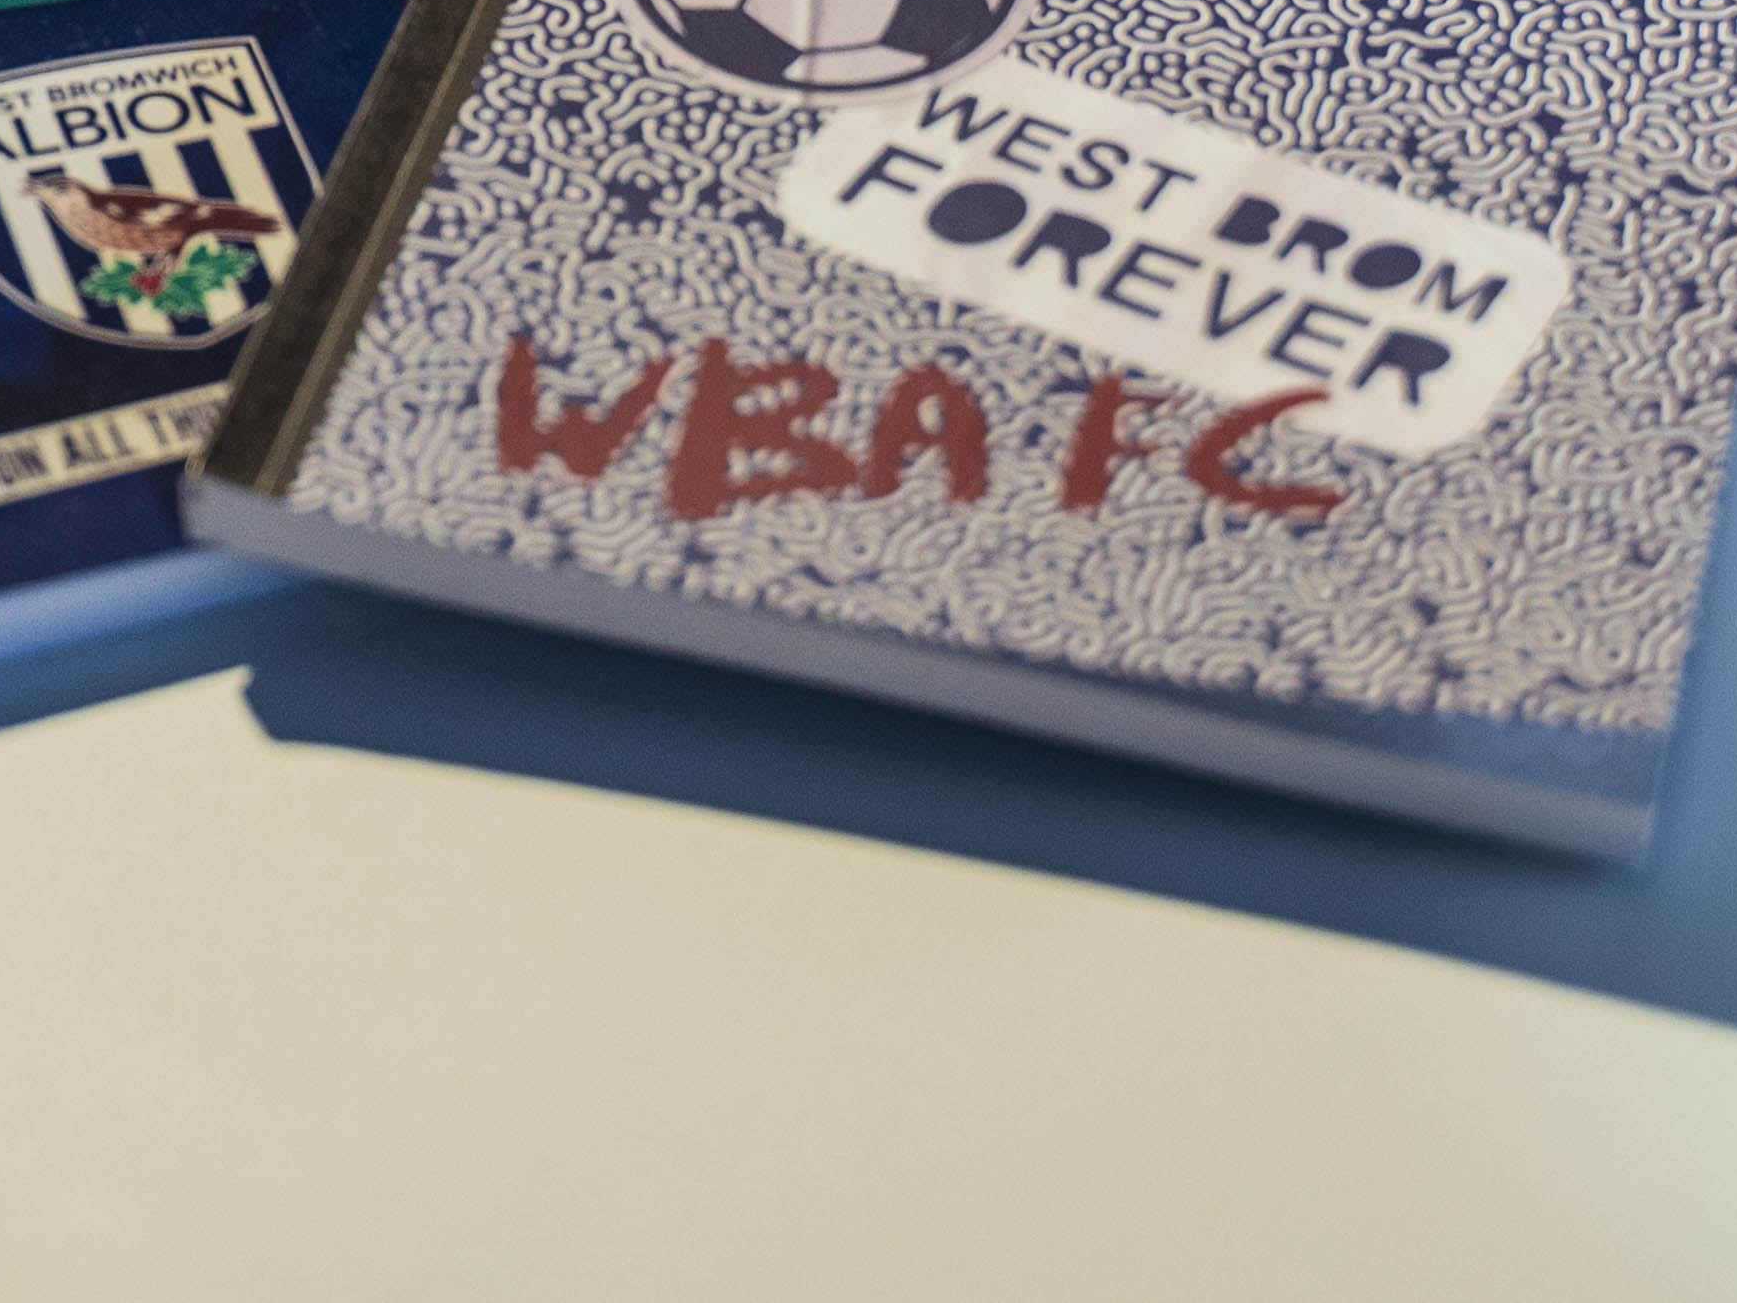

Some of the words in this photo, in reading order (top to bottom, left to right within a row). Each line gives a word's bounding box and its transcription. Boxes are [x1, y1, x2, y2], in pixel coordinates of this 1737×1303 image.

[47, 54, 238, 104] BROMWICH
[840, 143, 1452, 407] FOREVER
[914, 87, 1198, 213] WEST
[1214, 195, 1509, 322] BROM
[61, 423, 134, 472] ALL
